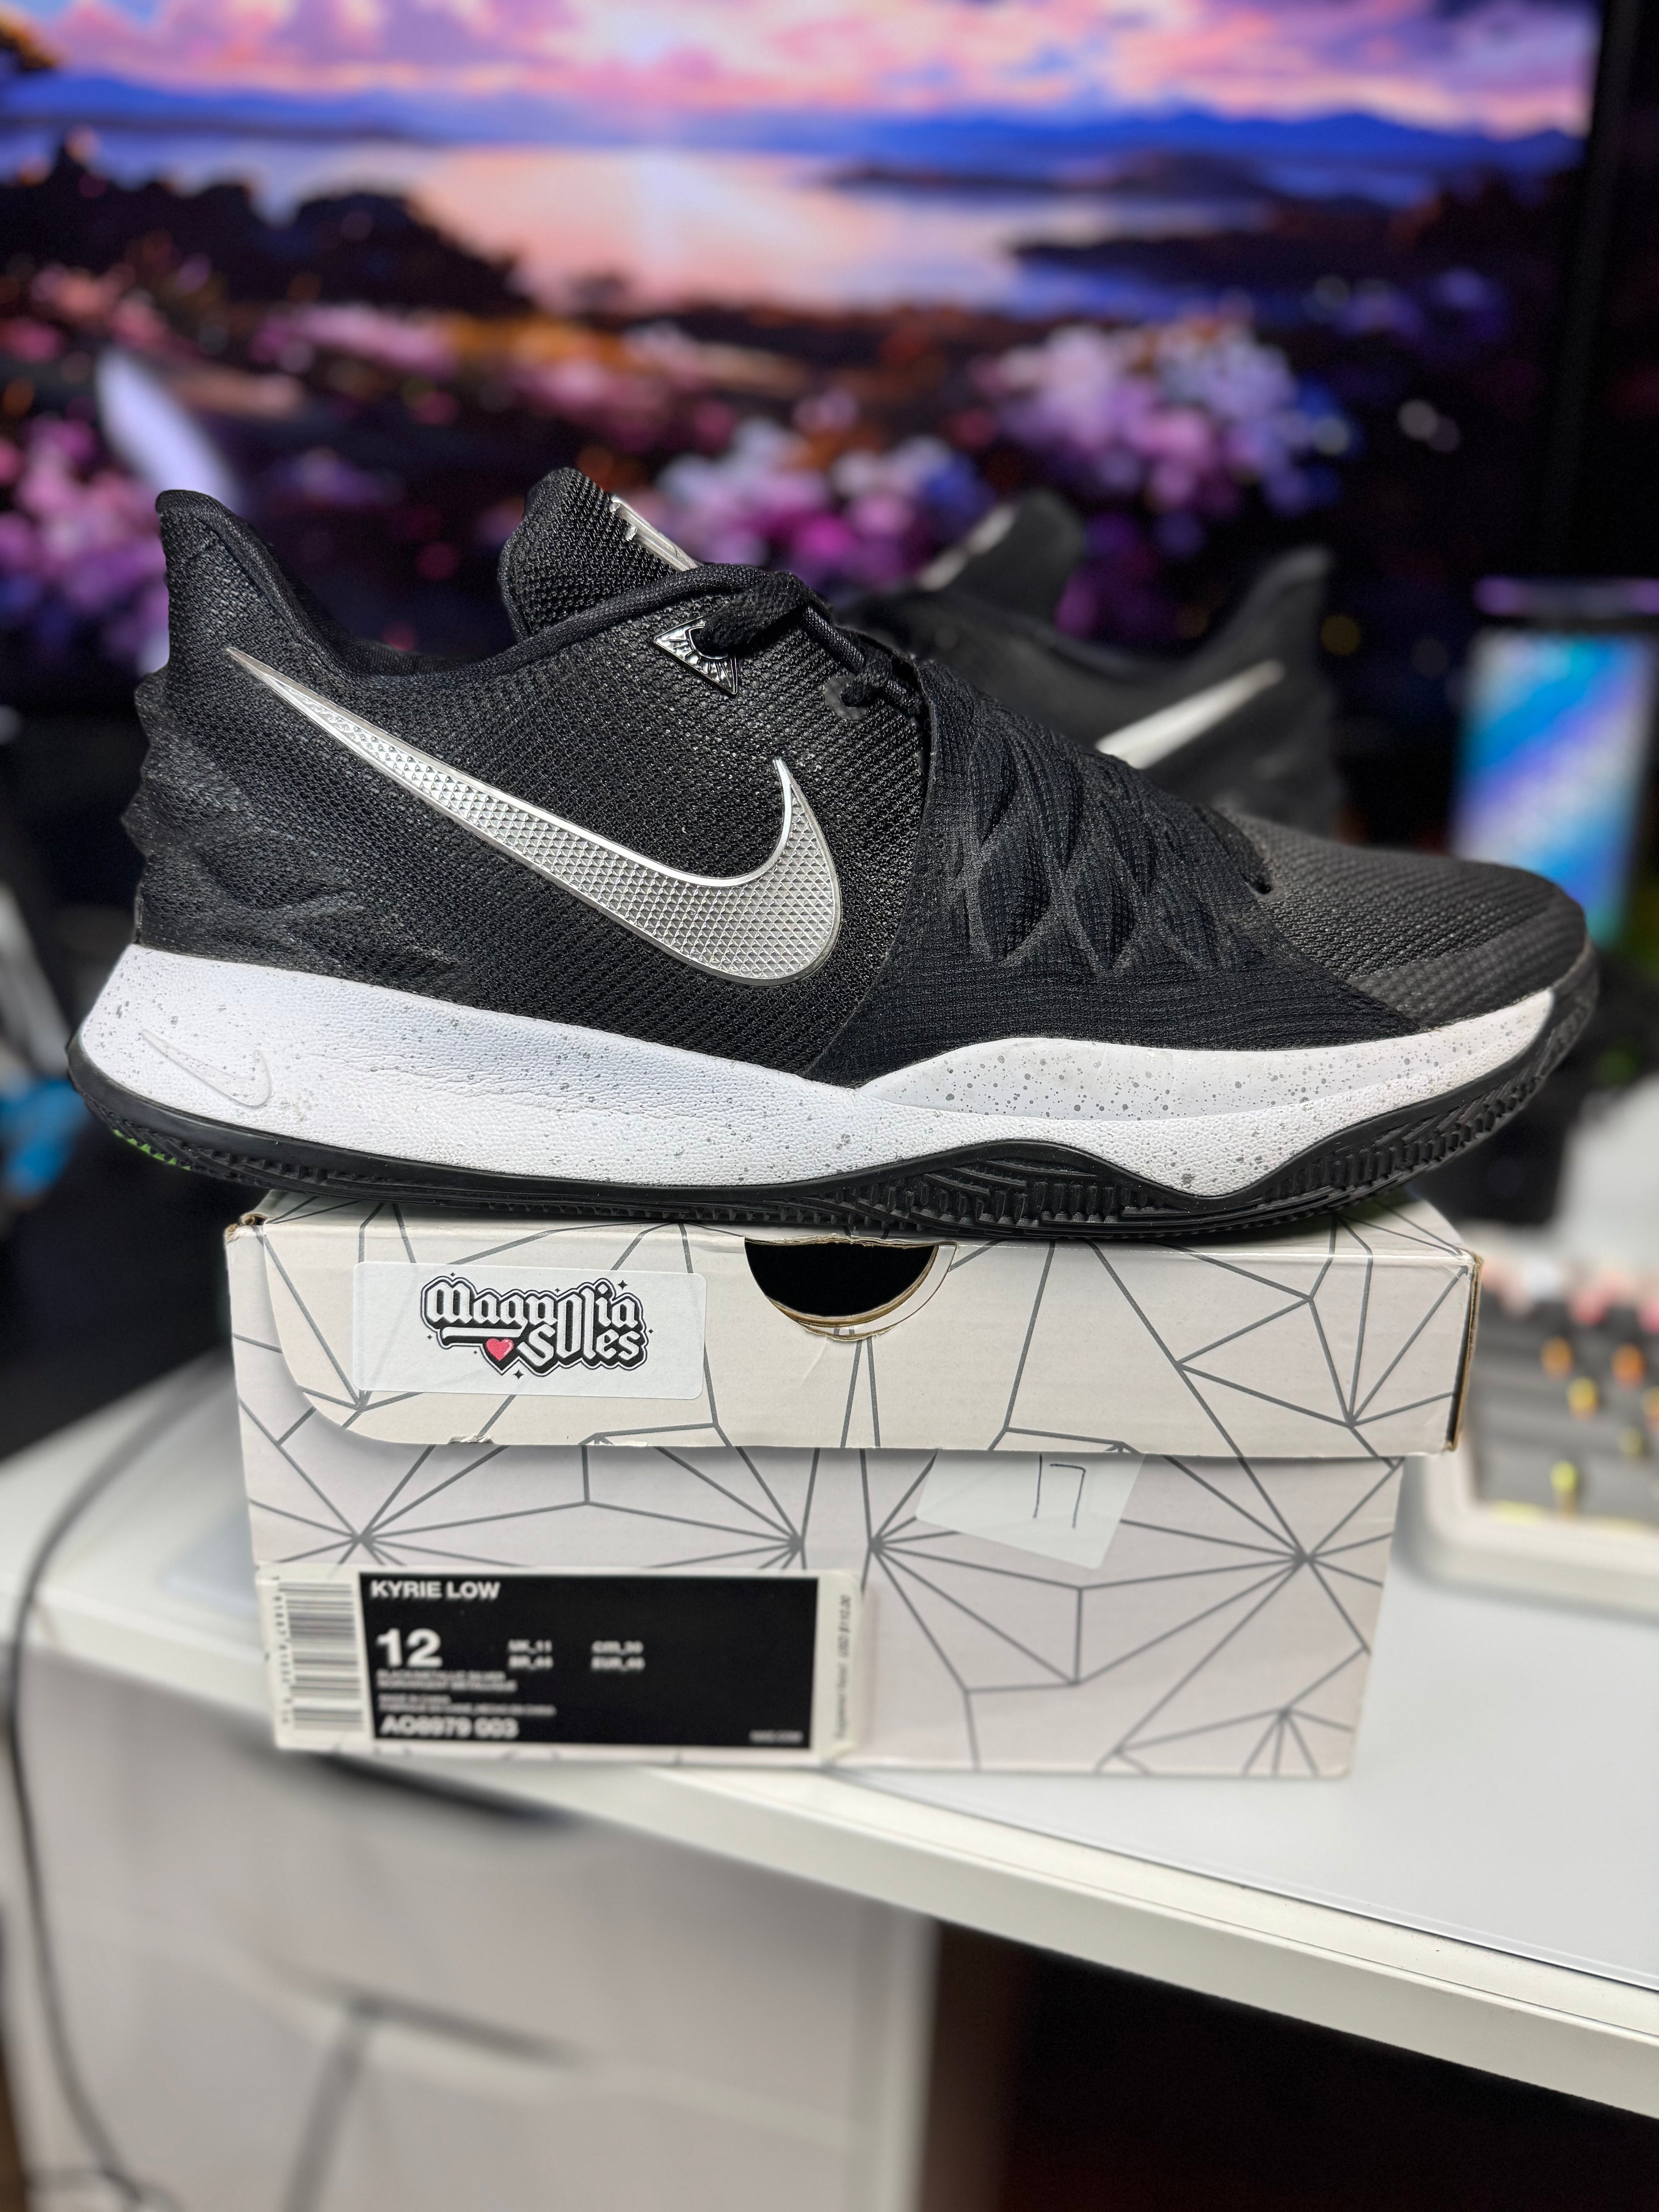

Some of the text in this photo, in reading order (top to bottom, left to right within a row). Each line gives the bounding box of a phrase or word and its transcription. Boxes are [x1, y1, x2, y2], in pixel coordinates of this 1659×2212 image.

[370, 1580, 501, 1599] KYRIE LOW
[376, 1627, 444, 1668] 12
